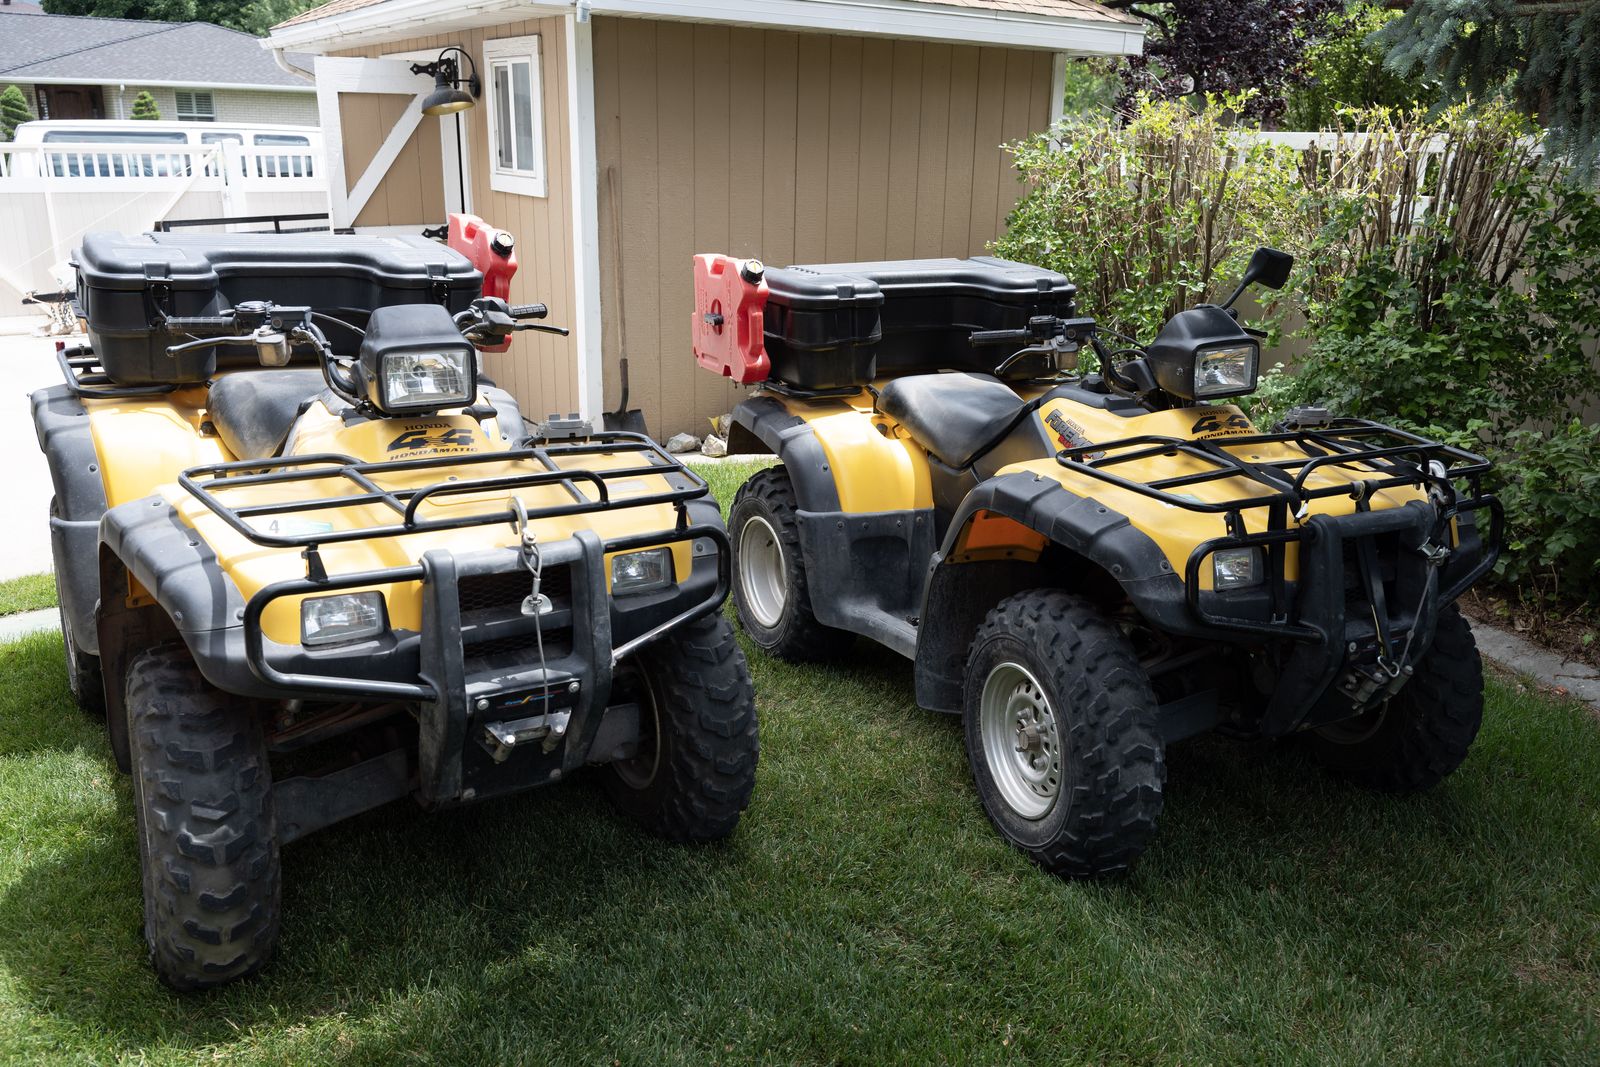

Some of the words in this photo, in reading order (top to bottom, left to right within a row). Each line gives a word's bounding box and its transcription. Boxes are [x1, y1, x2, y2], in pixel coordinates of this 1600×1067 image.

[1199, 409, 1231, 417] HONDA
[404, 423, 452, 431] HONDA
[1066, 418, 1087, 436] HONDA
[390, 447, 479, 461] HONDAMATIC
[268, 519, 280, 534] 4
